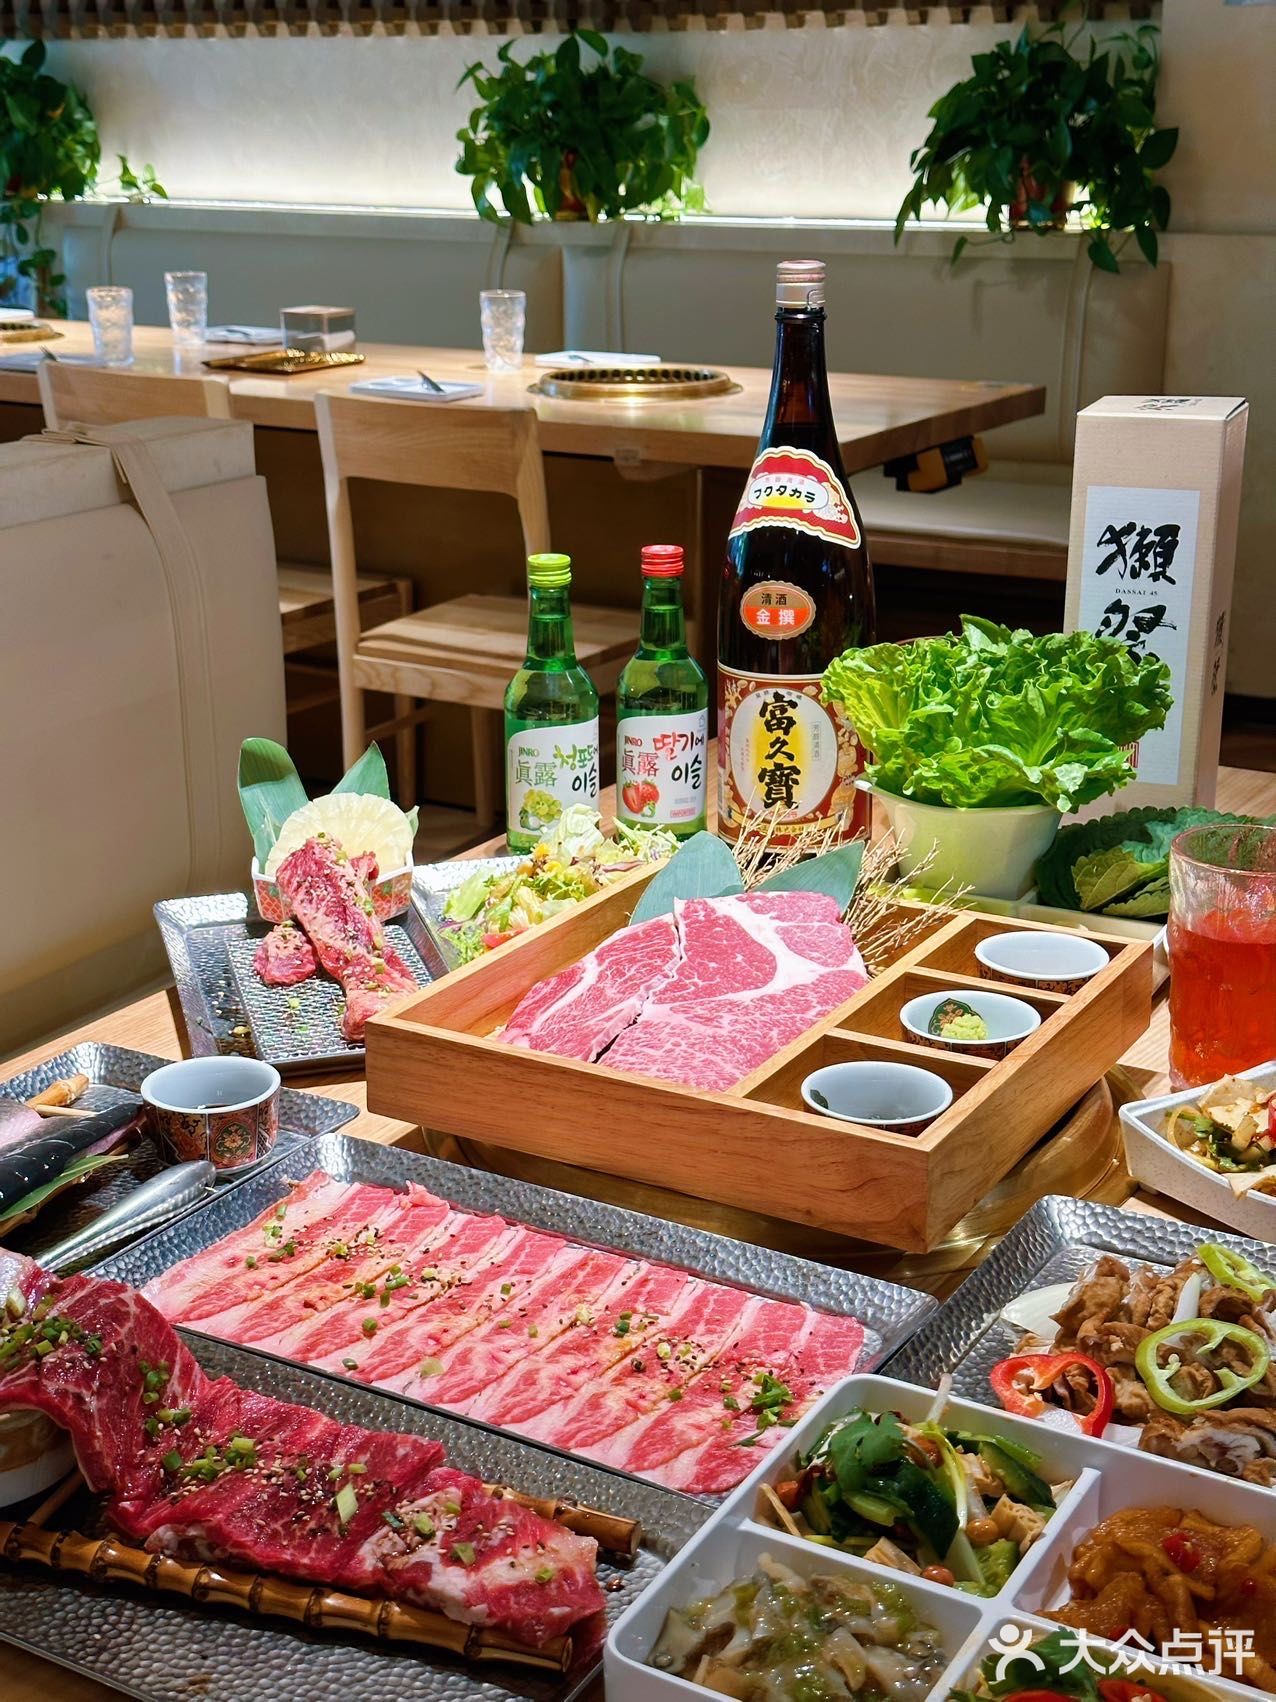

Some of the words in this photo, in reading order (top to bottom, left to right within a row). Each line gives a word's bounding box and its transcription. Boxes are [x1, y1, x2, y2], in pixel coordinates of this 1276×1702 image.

[754, 485, 816, 503] フクタカラ
[761, 592, 788, 605] 清酒
[756, 608, 795, 625] 金撰
[652, 731, 705, 760] 딸기에
[671, 753, 702, 790] 이슬
